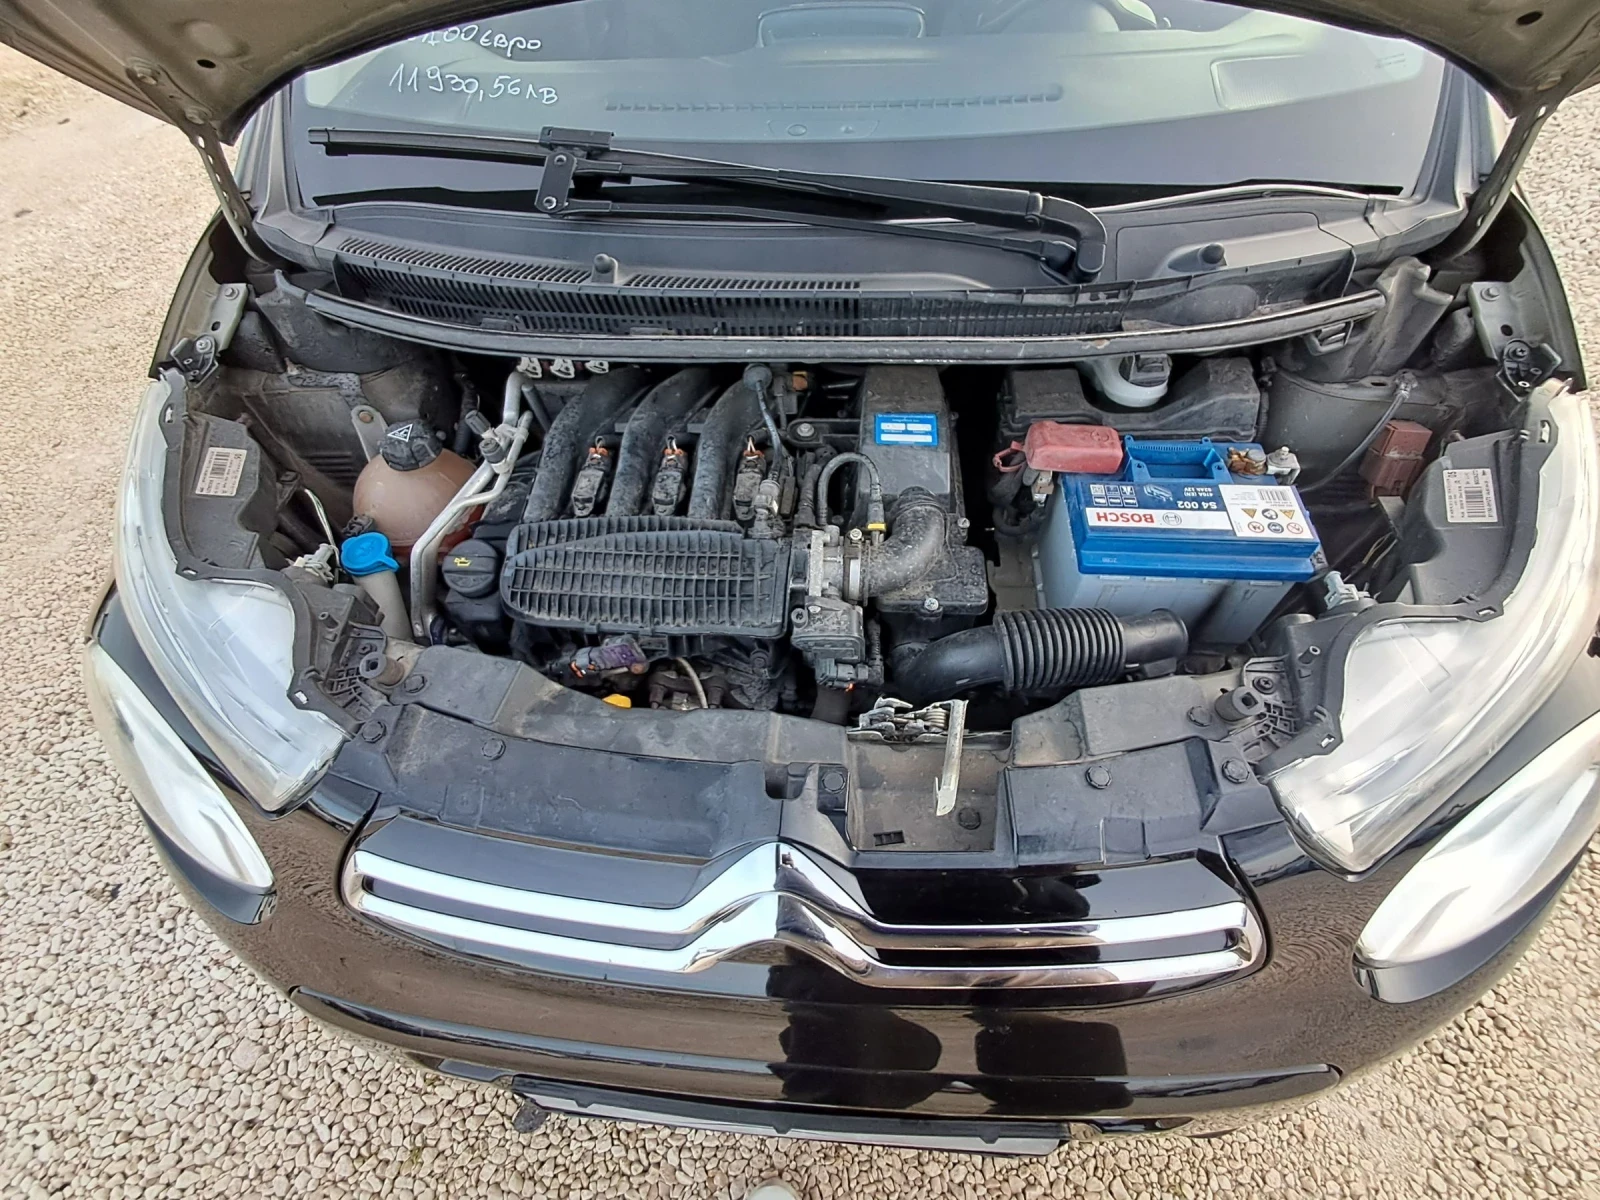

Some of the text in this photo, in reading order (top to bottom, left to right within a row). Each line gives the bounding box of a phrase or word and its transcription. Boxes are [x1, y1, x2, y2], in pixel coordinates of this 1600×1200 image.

[1176, 500, 1218, 510] S4 002
[1096, 511, 1155, 524] BOSCH
